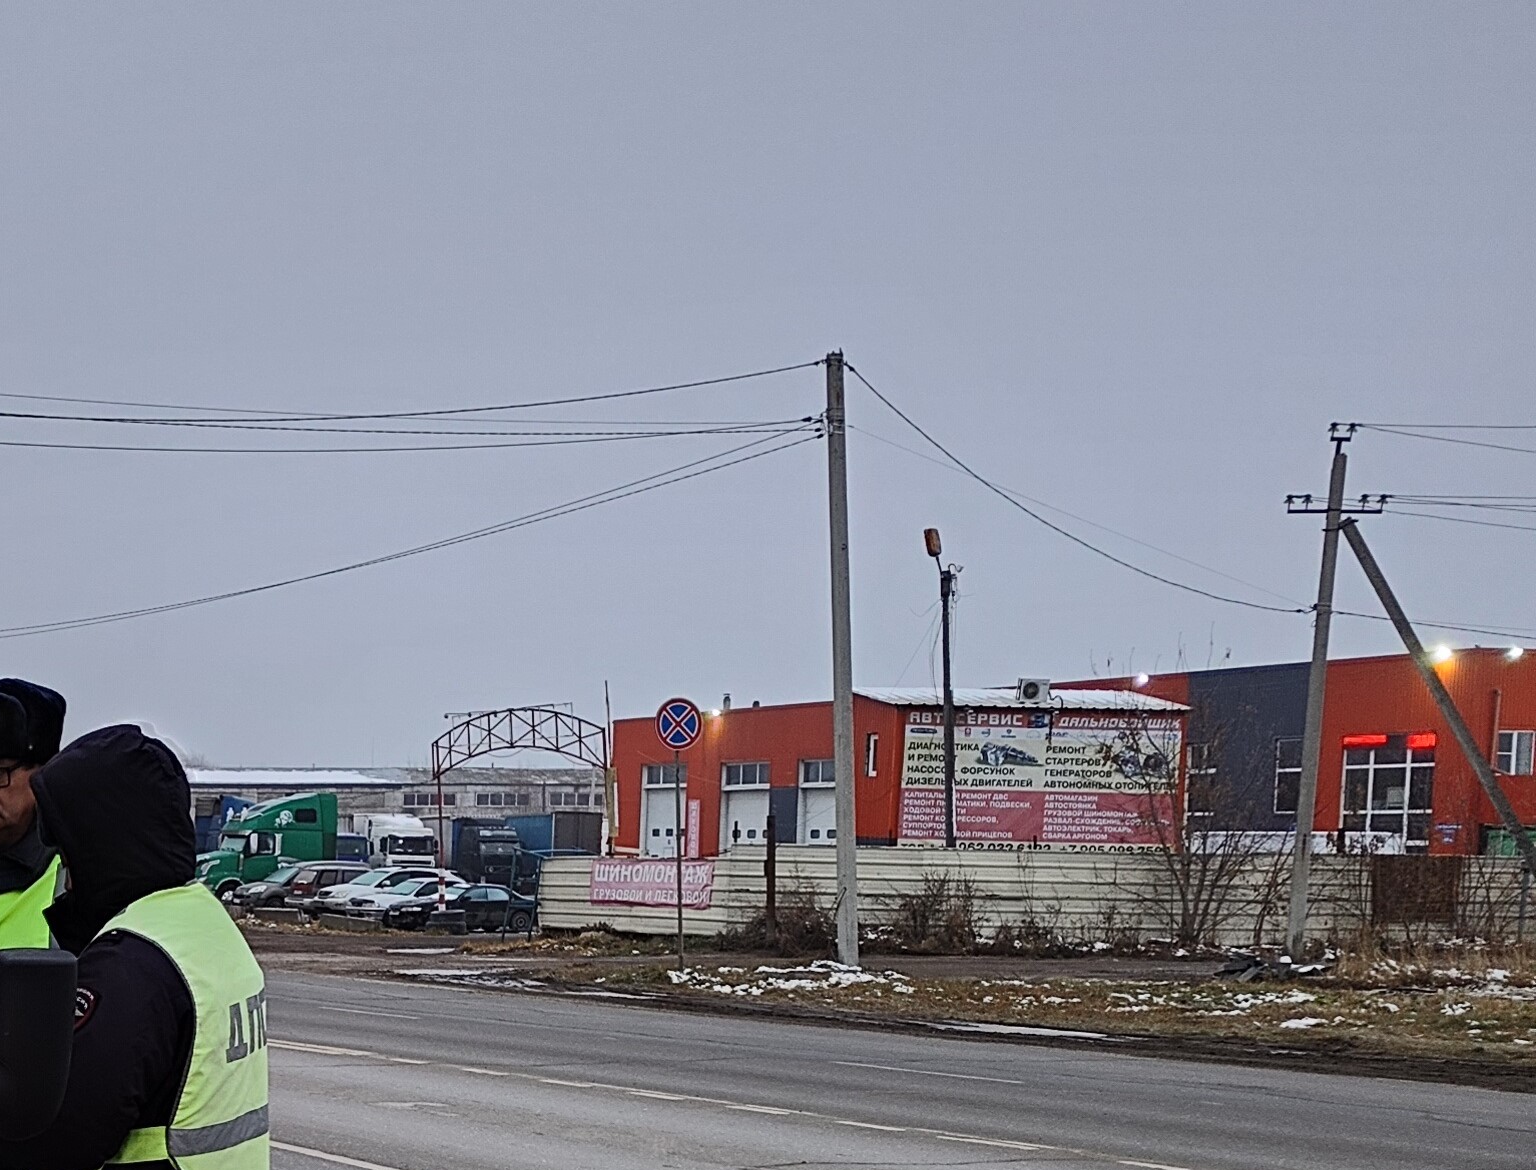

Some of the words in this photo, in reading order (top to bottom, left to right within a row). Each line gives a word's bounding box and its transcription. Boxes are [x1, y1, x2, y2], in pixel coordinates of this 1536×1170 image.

[909, 712, 1023, 725] АВТСЕРВИС
[908, 741, 979, 751] ДИАГНОТИКА
[1046, 746, 1086, 754] РЕМОНТ
[917, 754, 958, 763] РЕМОТ
[907, 766, 948, 774] НАСОСО
[961, 767, 1016, 776] ФОРСУНОК
[1045, 769, 1112, 778] ГЕНЕРАТОРОВ
[906, 777, 968, 787] ДИЗЕЛЬЫХ
[970, 778, 1033, 788] ДВИГАТЕЛЕЙ
[1044, 780, 1112, 789] АВТОНОМНЫХ
[1044, 794, 1098, 802] АВТОМАГАЗИН
[904, 799, 934, 807] РЕМОНТ
[1044, 802, 1097, 810] АВТОСТОЯНКА
[904, 806, 941, 814] ХОДОВОЙ
[1044, 809, 1083, 817] ГРУЗОВОЙ
[903, 814, 934, 822] РЕМОНТ
[935, 815, 999, 824] КОРЕССОРОВ,
[902, 829, 932, 837] РЕМОНТ
[972, 831, 1013, 839] ПРИЦЕПОВ
[645, 889, 652, 901] И
